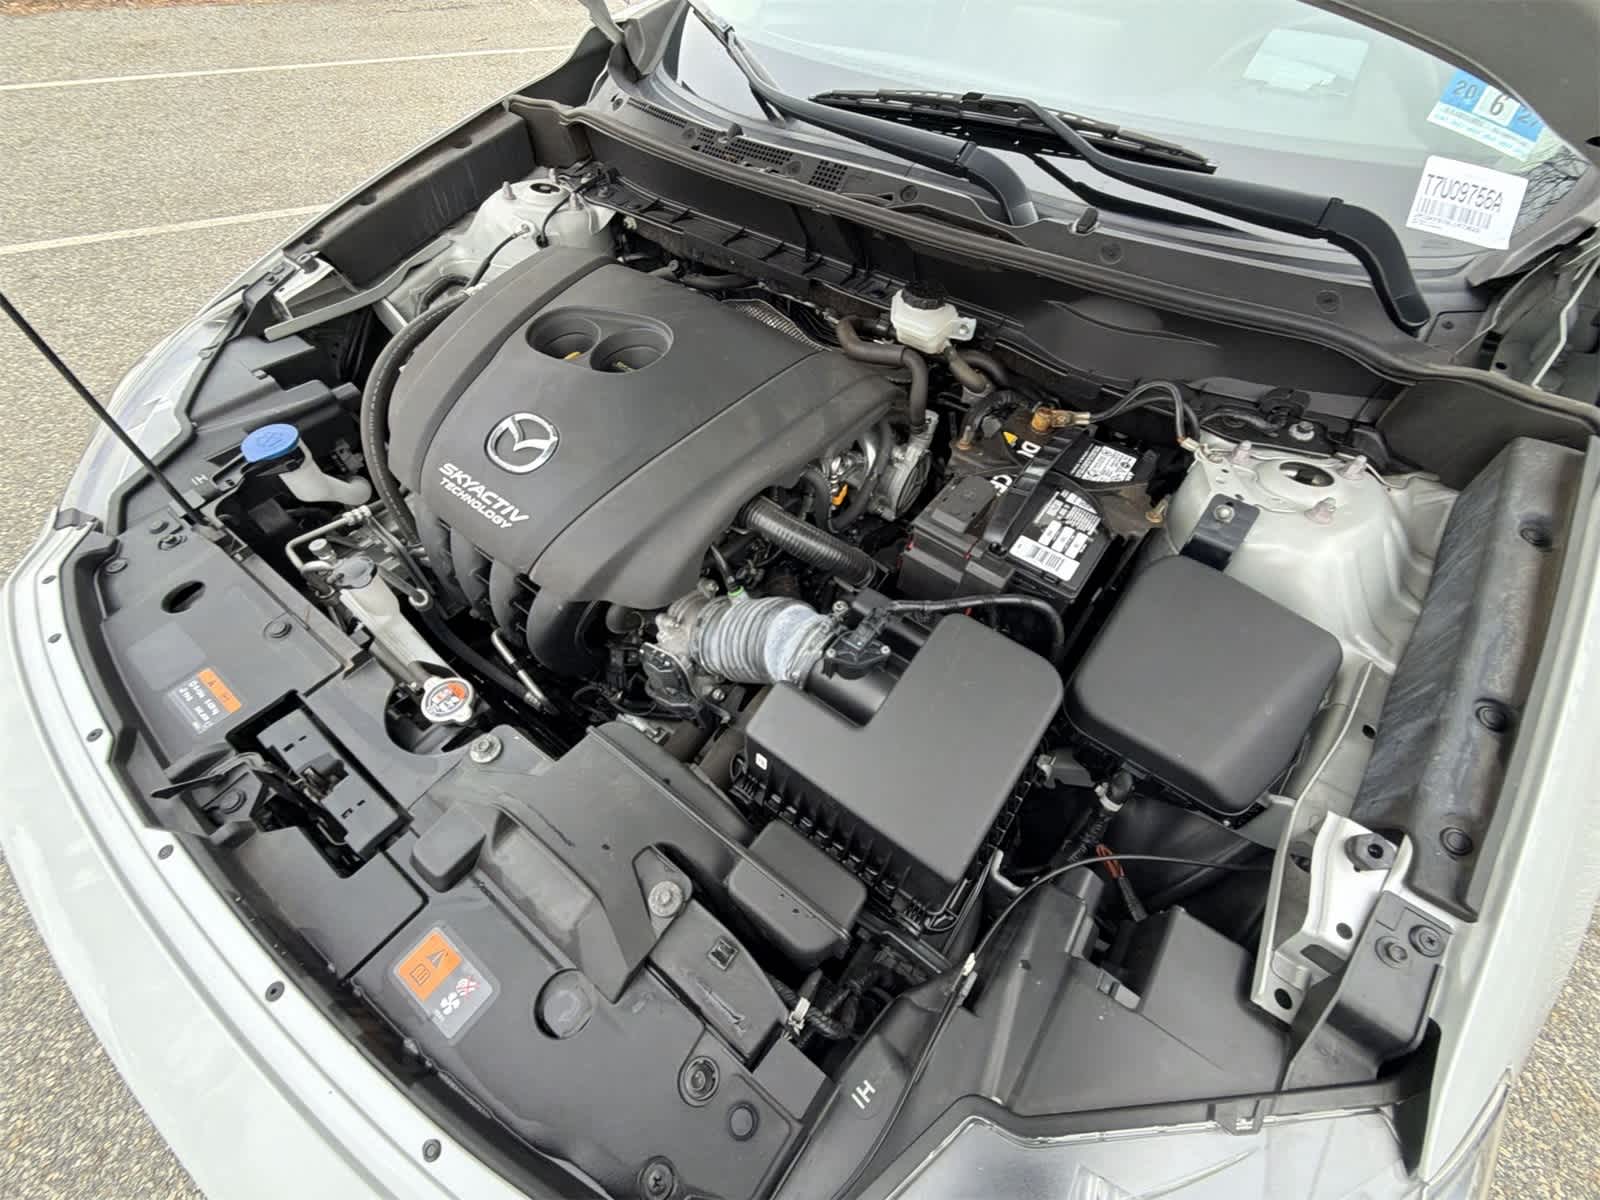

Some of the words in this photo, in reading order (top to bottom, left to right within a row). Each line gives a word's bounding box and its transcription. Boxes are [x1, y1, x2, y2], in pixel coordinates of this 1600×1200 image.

[1452, 79, 1478, 99] 20
[1489, 93, 1509, 116] 6
[438, 462, 530, 522] SKYACTIV
[440, 477, 513, 529] TECHNOLOGY
